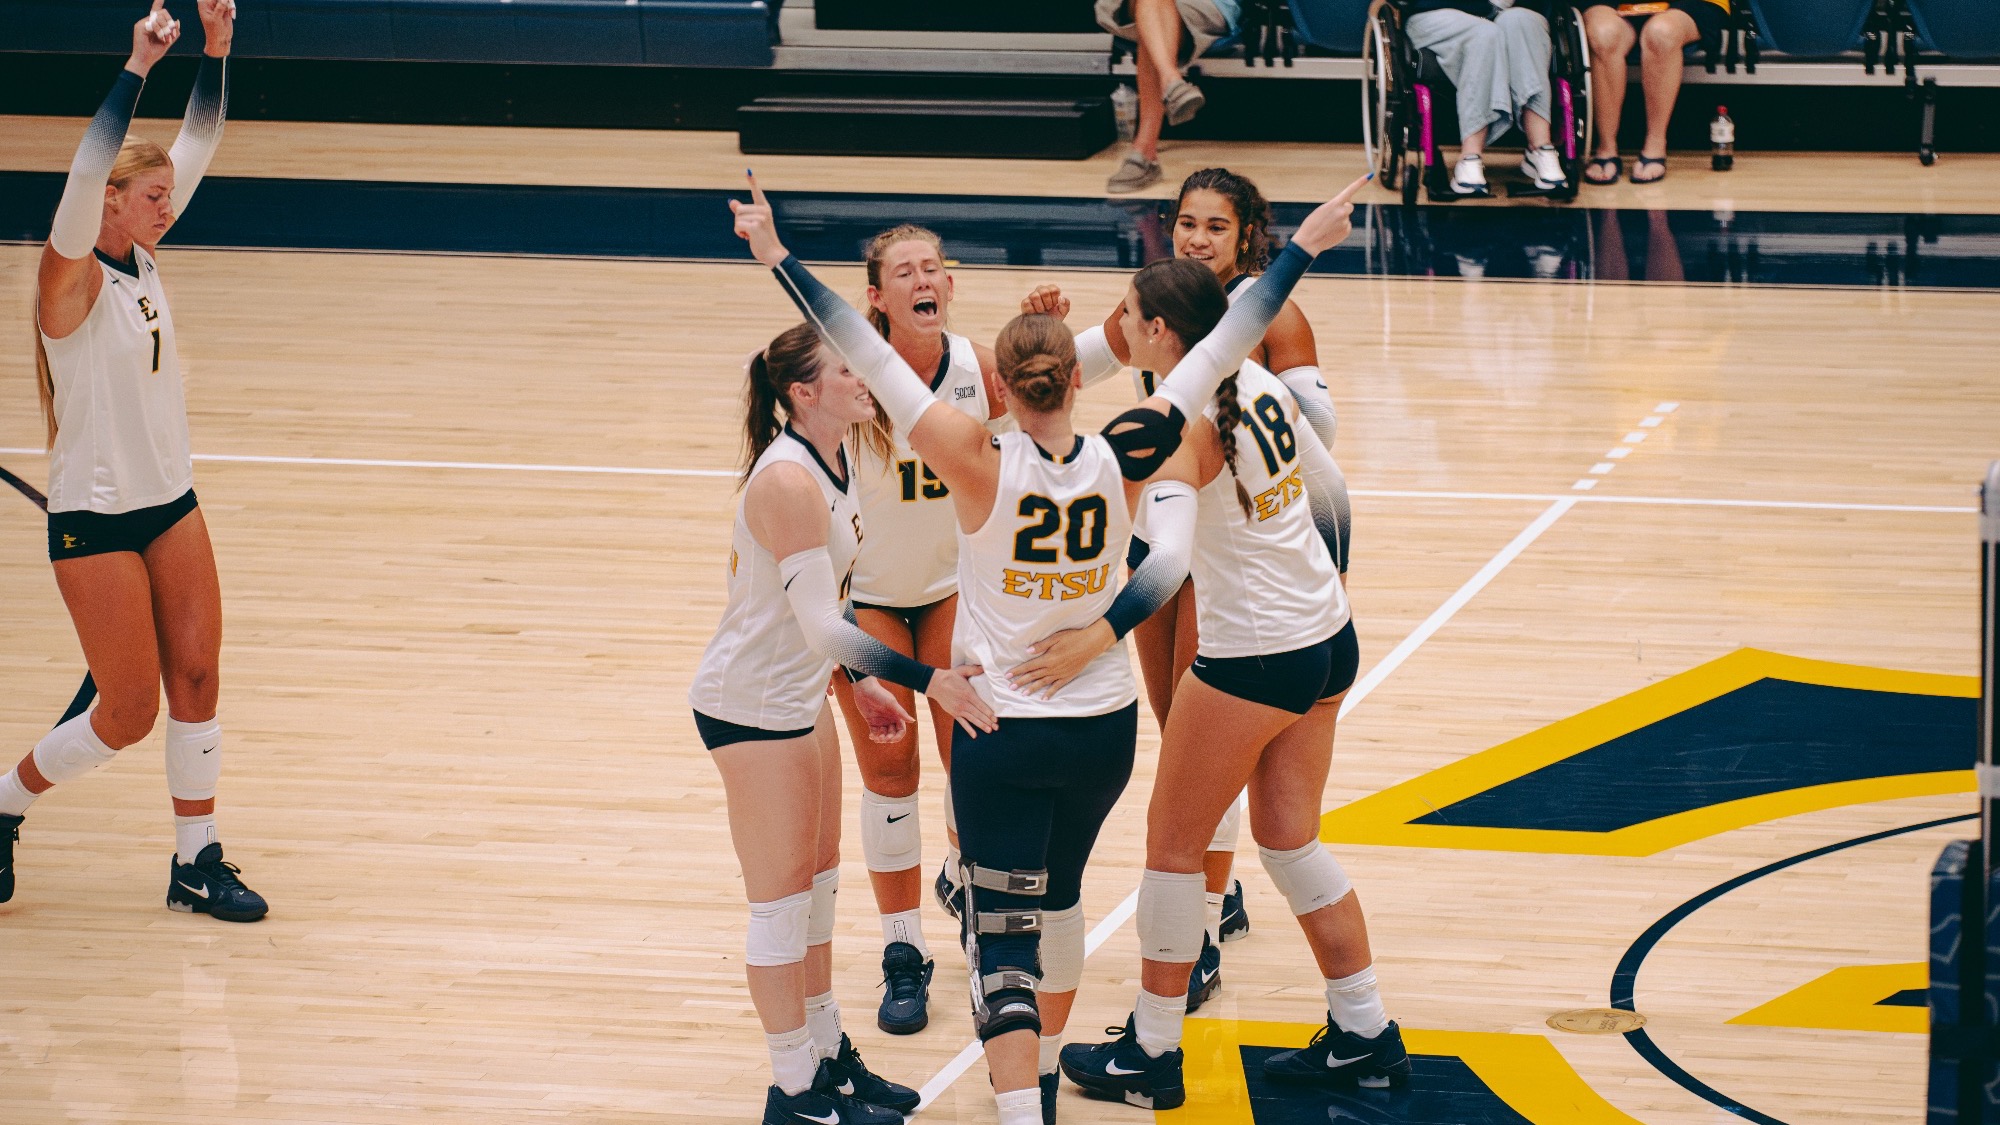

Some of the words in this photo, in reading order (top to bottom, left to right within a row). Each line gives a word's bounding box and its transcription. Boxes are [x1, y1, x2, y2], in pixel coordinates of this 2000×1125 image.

[1240, 392, 1296, 479] 18
[1254, 465, 1303, 522] ETS
[1012, 491, 1108, 564] 20
[1002, 563, 1110, 601] ETSU
